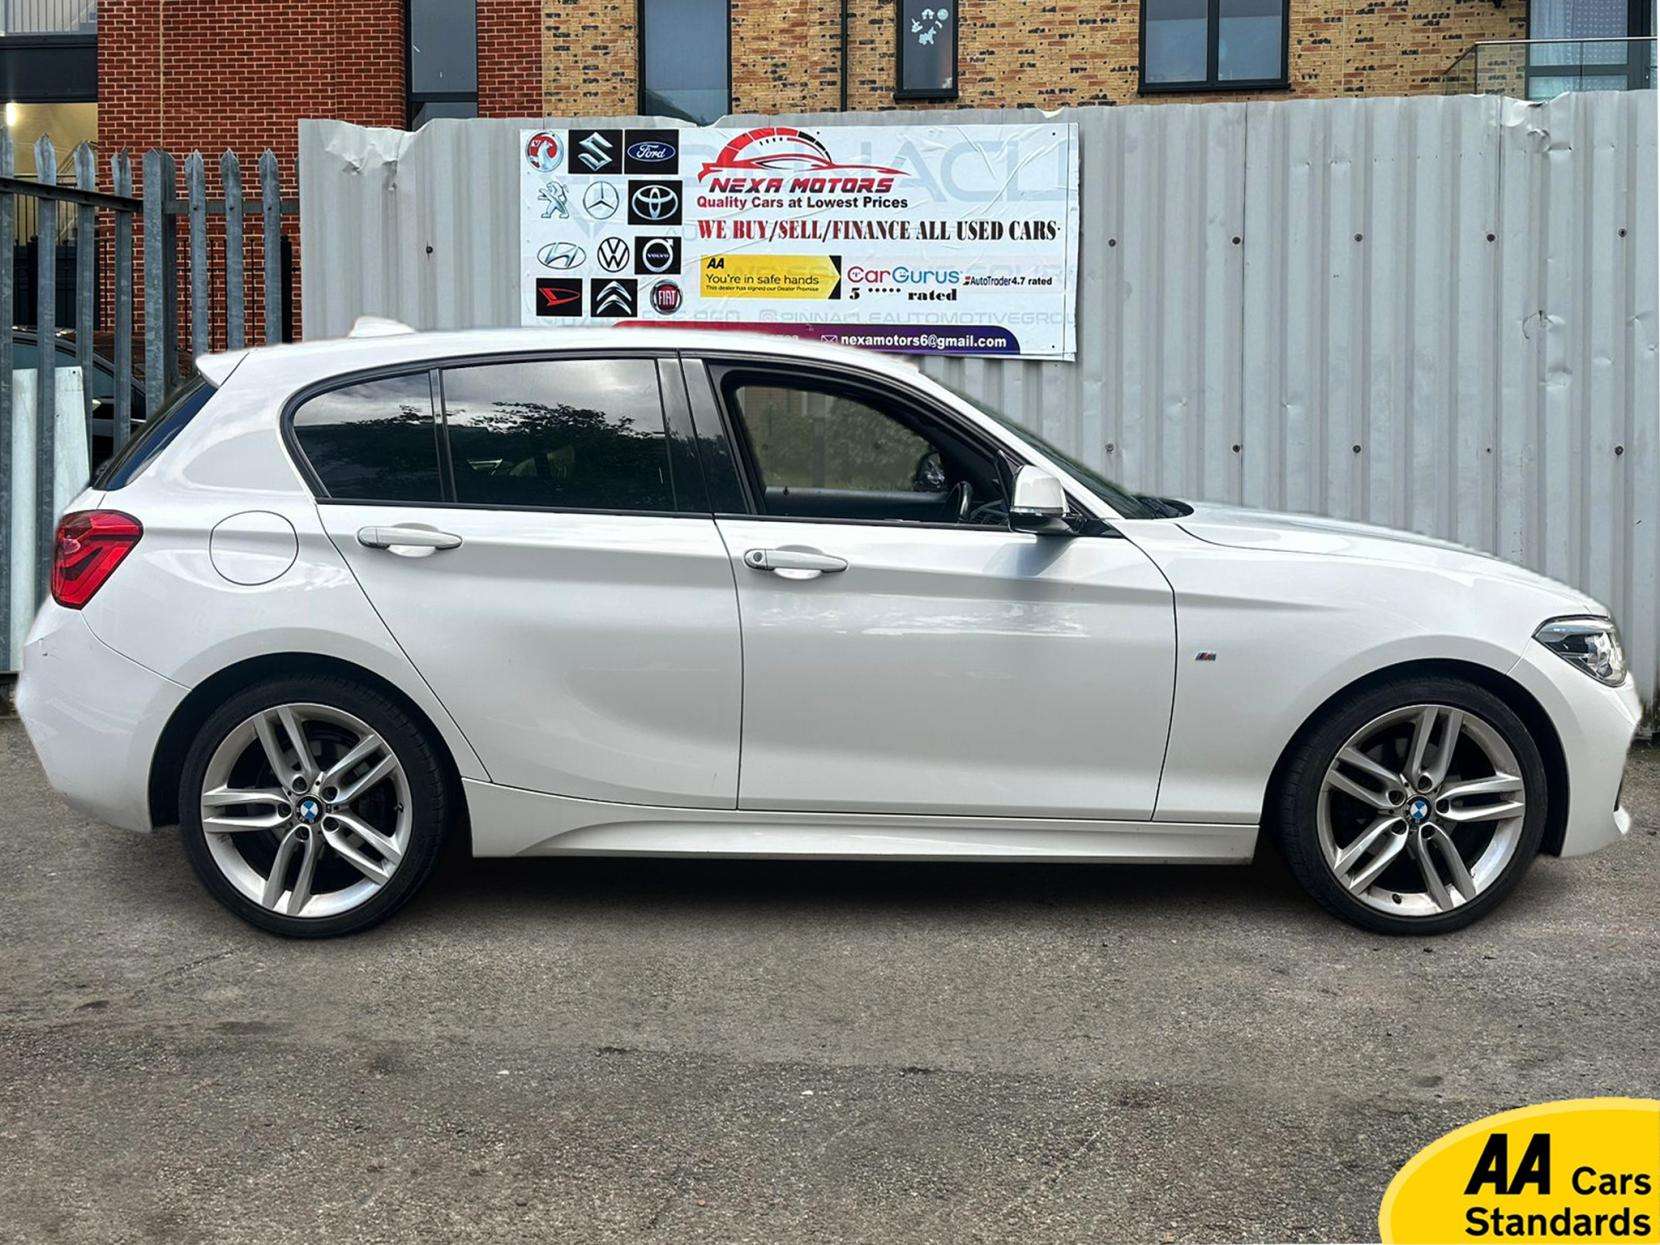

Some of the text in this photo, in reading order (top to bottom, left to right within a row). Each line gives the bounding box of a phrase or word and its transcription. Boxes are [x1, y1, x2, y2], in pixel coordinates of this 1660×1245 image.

[636, 145, 665, 159] Ford
[709, 177, 894, 193] NEXA MOTORS
[697, 195, 907, 210] Quality Cars at Lowest Prices
[697, 220, 727, 239] WE
[733, 219, 911, 243] BUY/SELL/FINANCE
[916, 220, 950, 240] ALL
[956, 220, 1003, 241] USED
[1009, 220, 1057, 240] CARS
[707, 257, 724, 269] AA
[706, 274, 819, 285] You're in safe hands
[847, 266, 960, 284] CarGurus
[1028, 277, 1053, 286] rated
[658, 290, 676, 306] FIAT
[849, 287, 957, 301] 5 rated
[841, 334, 1007, 349] nexamotors6@gmail.com
